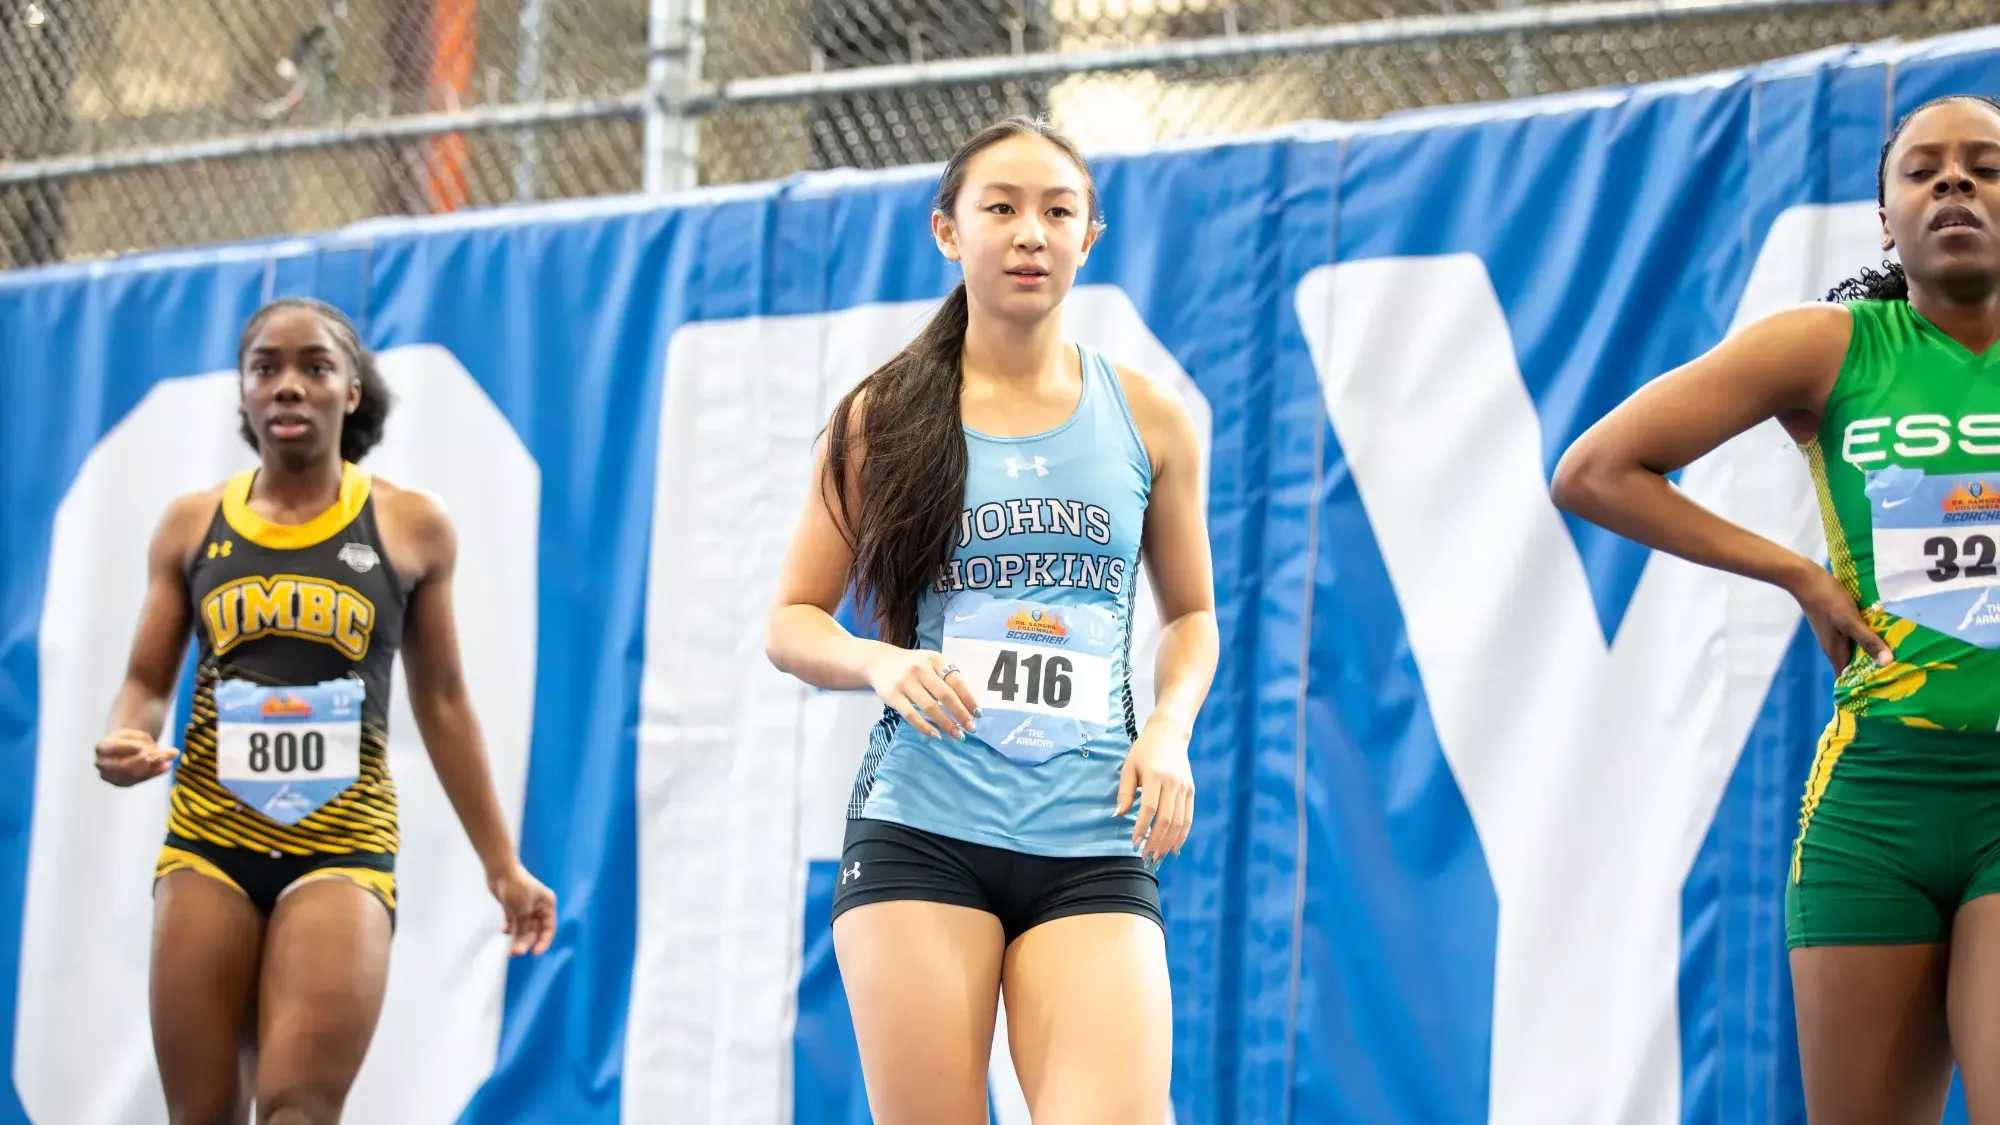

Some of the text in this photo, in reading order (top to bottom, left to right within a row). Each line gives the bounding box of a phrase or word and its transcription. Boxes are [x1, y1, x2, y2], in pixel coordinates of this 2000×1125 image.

[1842, 414, 2000, 463] ESS
[957, 498, 1111, 549] JOHNS
[933, 553, 1126, 595] HOPKINS
[1924, 534, 1997, 582] 32
[202, 574, 375, 661] UMBC
[987, 650, 1073, 708] 416
[249, 732, 324, 773] 800
[1016, 736, 1054, 748] ARMORY
[1027, 728, 1044, 738] THE
